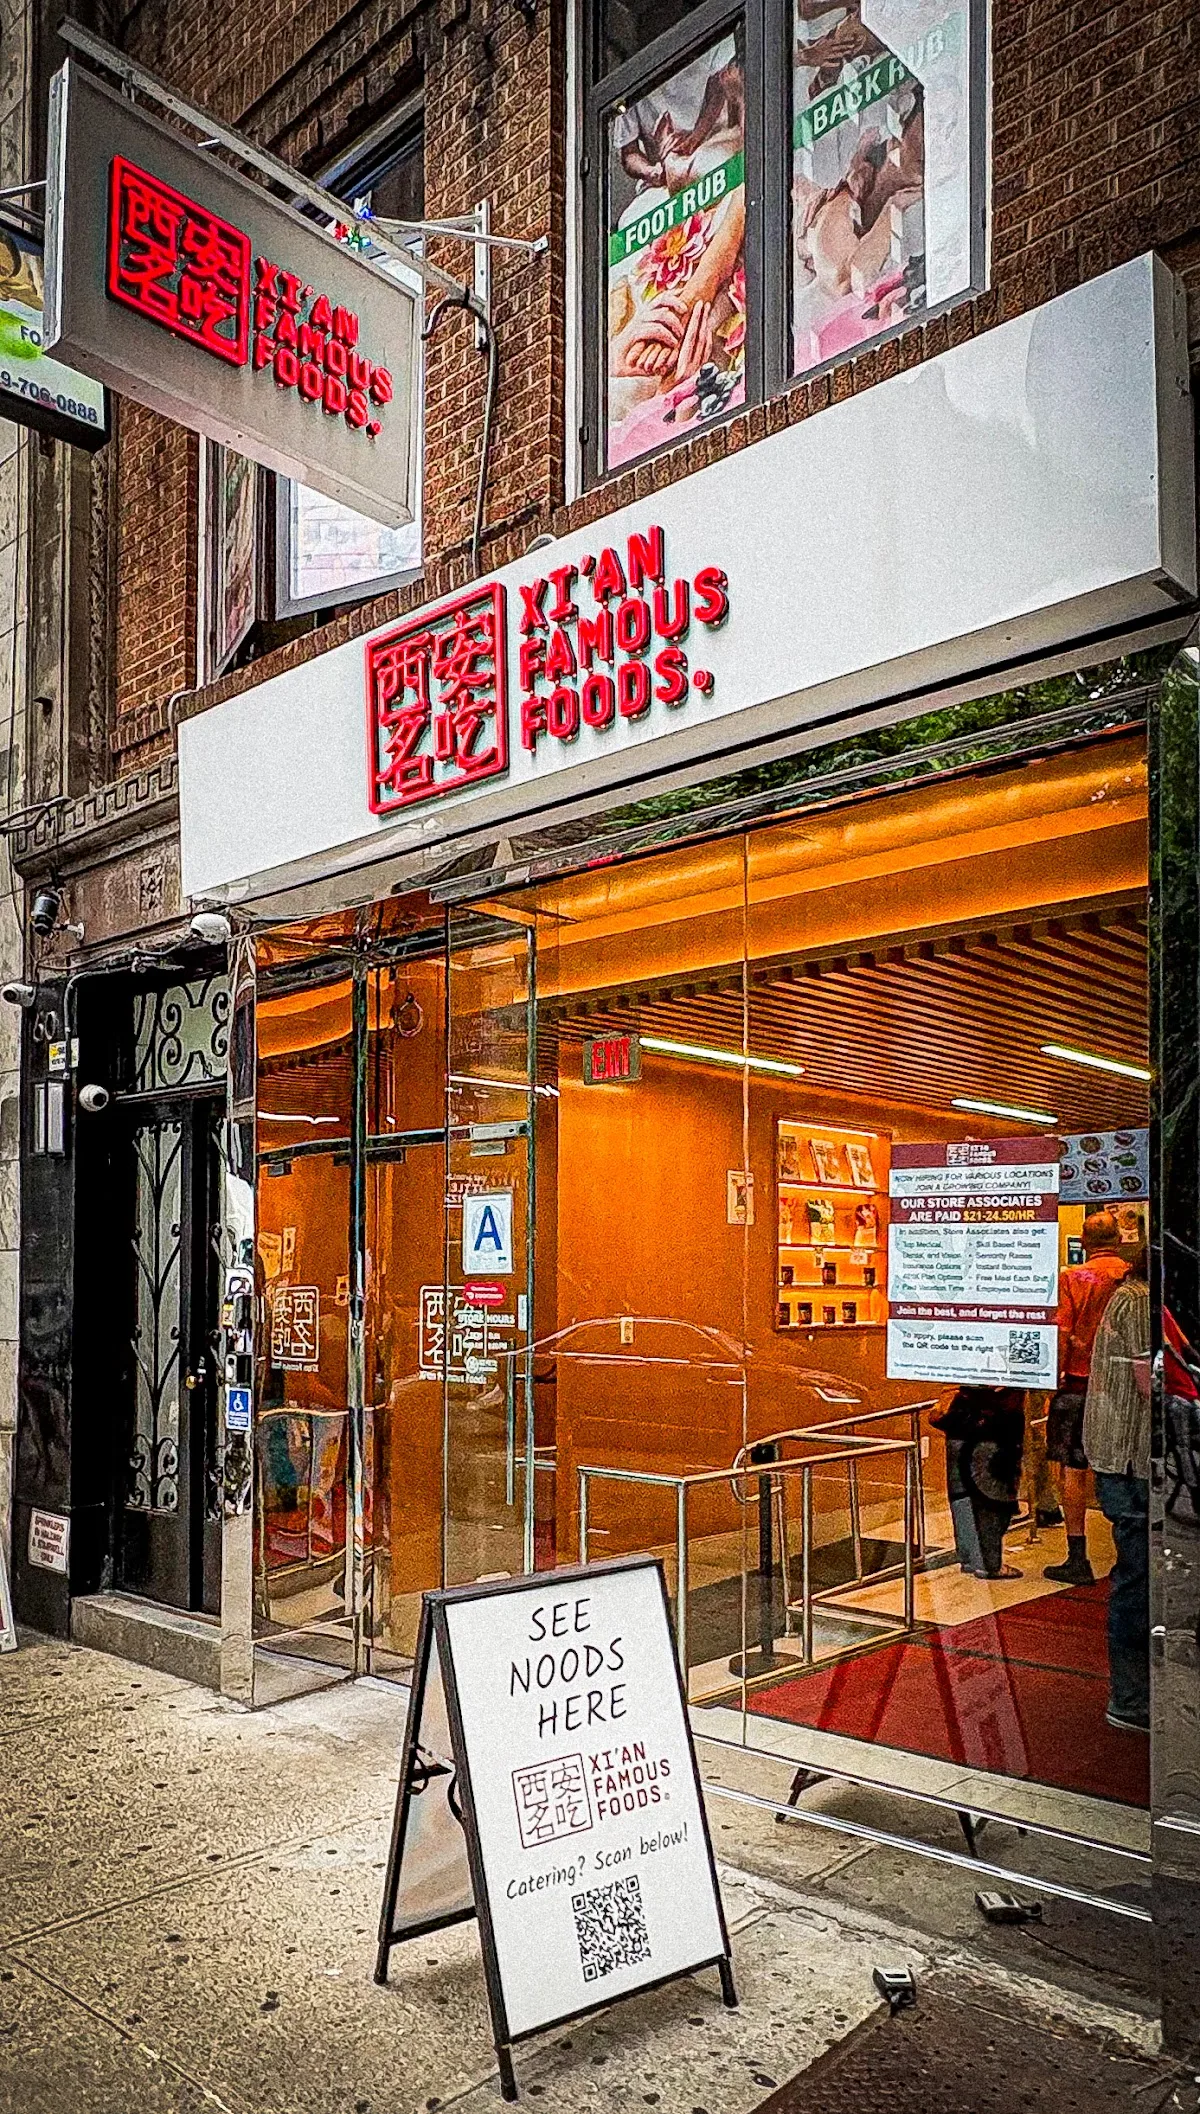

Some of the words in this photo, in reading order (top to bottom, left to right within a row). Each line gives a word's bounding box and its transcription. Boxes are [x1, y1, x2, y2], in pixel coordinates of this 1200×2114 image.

[812, 73, 882, 136] BACK
[624, 203, 676, 254] FOOT
[681, 168, 728, 217] RUB
[255, 256, 359, 349] XI'AN
[254, 294, 393, 405] FAMOUS
[518, 525, 664, 634] XI'AN
[519, 566, 728, 693] FAMOUS
[592, 1037, 631, 1079] EXIT
[915, 1184, 934, 1192] JOIN
[945, 1173, 963, 1181] FOR
[965, 1171, 1001, 1180] VARIOUS
[1004, 1169, 1054, 1179] LOCATIONS
[900, 1198, 926, 1209] OUR
[927, 1197, 965, 1209] STORE
[967, 1195, 1042, 1208] ASSOCIATES
[909, 1211, 932, 1222] ARE
[935, 1211, 961, 1222] PAID
[963, 1210, 1036, 1222] $21-24.50/HR
[473, 1205, 503, 1252] A
[943, 1227, 964, 1236] Store
[966, 1227, 1010, 1236] Associates
[1012, 1227, 1029, 1236] also
[993, 1240, 1015, 1248] Based
[976, 1274, 992, 1282] Free
[1001, 1263, 1032, 1271] Bonuses
[976, 1285, 1011, 1294] Employee
[486, 1313, 516, 1324] HOURS
[896, 1306, 916, 1316] Join
[917, 1307, 932, 1317] the
[958, 1307, 978, 1317] and
[979, 1308, 1007, 1320] forget
[1008, 1309, 1024, 1319] the
[1026, 1310, 1046, 1320] rest
[902, 1331, 912, 1339] To
[937, 1332, 963, 1342] please
[916, 1341, 928, 1350] QR
[930, 1343, 949, 1351] code
[962, 1344, 973, 1352] the
[975, 1345, 994, 1355] right
[529, 1598, 591, 1641] SEE
[510, 1637, 624, 1697] NOODS
[538, 1683, 627, 1739] HERE
[588, 1741, 646, 1775] XI'AN
[517, 1763, 582, 1809] 西安
[593, 1759, 671, 1798] FAMOUS
[526, 1796, 588, 1839] 名吃
[506, 1855, 586, 1900] Catering?
[594, 1847, 632, 1870] Scan
[640, 1822, 688, 1855] below!
